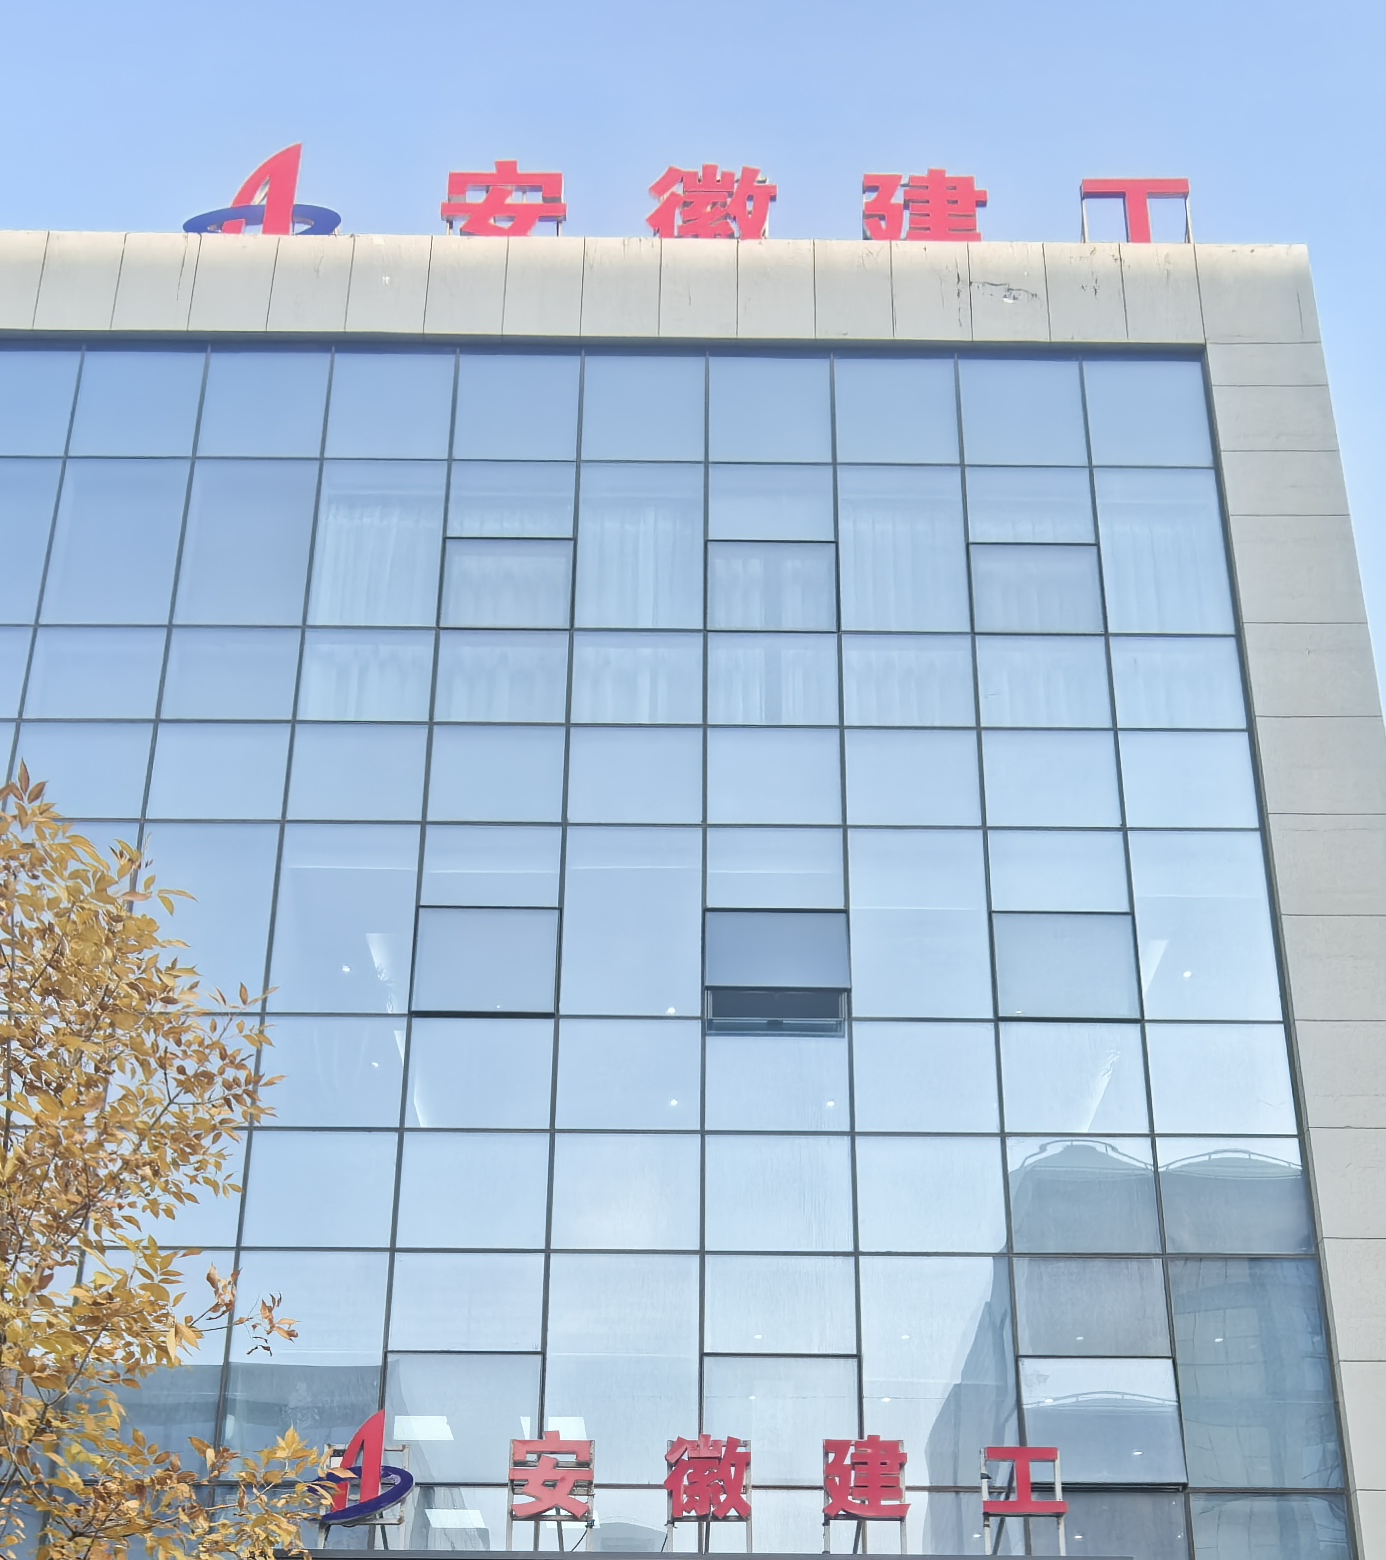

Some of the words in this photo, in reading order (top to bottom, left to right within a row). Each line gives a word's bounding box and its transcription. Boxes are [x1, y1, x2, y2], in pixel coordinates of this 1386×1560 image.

[440, 161, 1190, 243] 安徽建工
[509, 1430, 1069, 1521] 安徽建工
